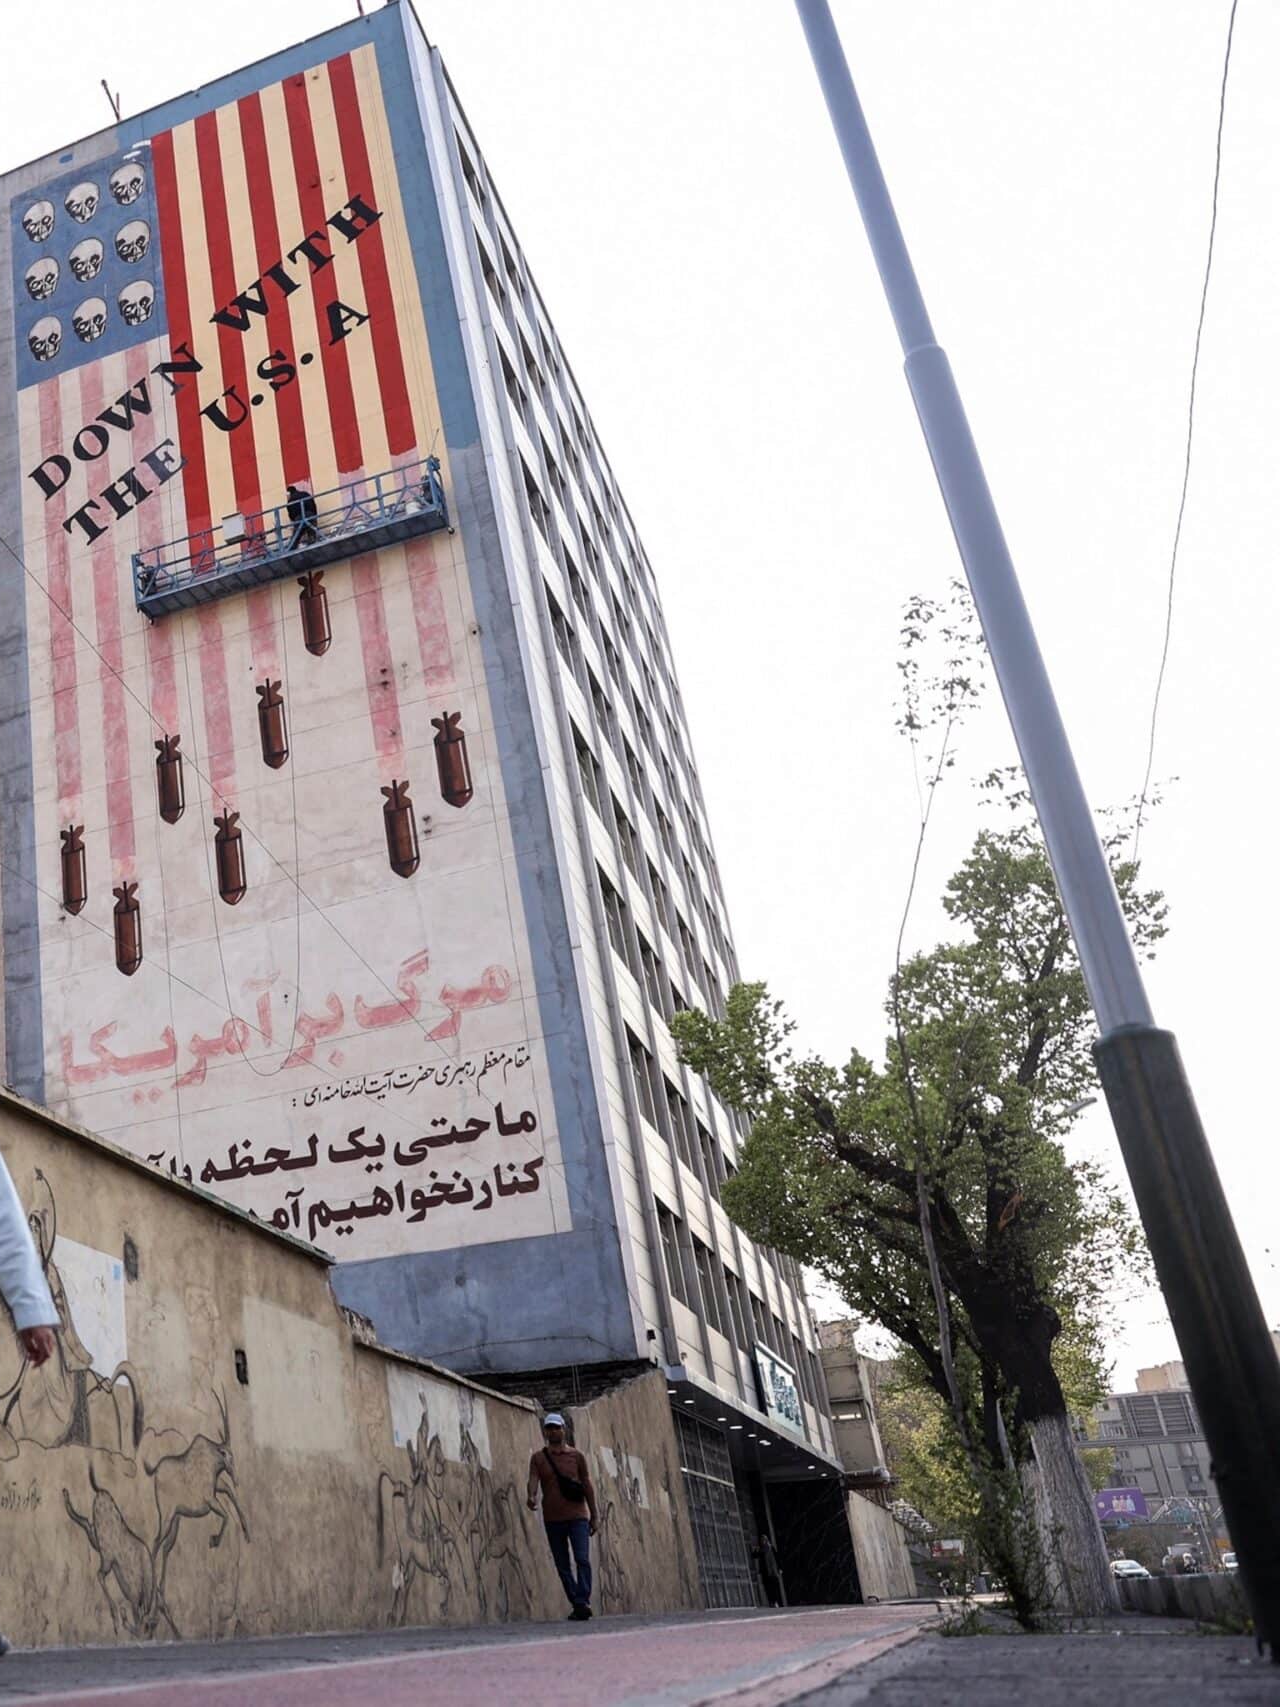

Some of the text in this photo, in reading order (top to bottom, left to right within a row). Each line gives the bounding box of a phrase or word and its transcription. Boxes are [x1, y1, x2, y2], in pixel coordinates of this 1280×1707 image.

[28, 194, 383, 501] DOWN WITH
[63, 438, 188, 546] THE
[353, 948, 513, 1042] مرگ
[281, 991, 345, 1069] بر
[392, 1065, 436, 1096] حضرت
[434, 1060, 477, 1088] رهبری
[477, 1051, 506, 1097] معظم
[503, 1046, 531, 1086] مقام
[393, 1117, 491, 1167] حتی
[494, 1102, 538, 1137] ما
[200, 1133, 320, 1184] لحظه
[328, 1126, 386, 1174] یک
[308, 1170, 475, 1242] نخواهیم
[472, 1156, 545, 1211] کنار
